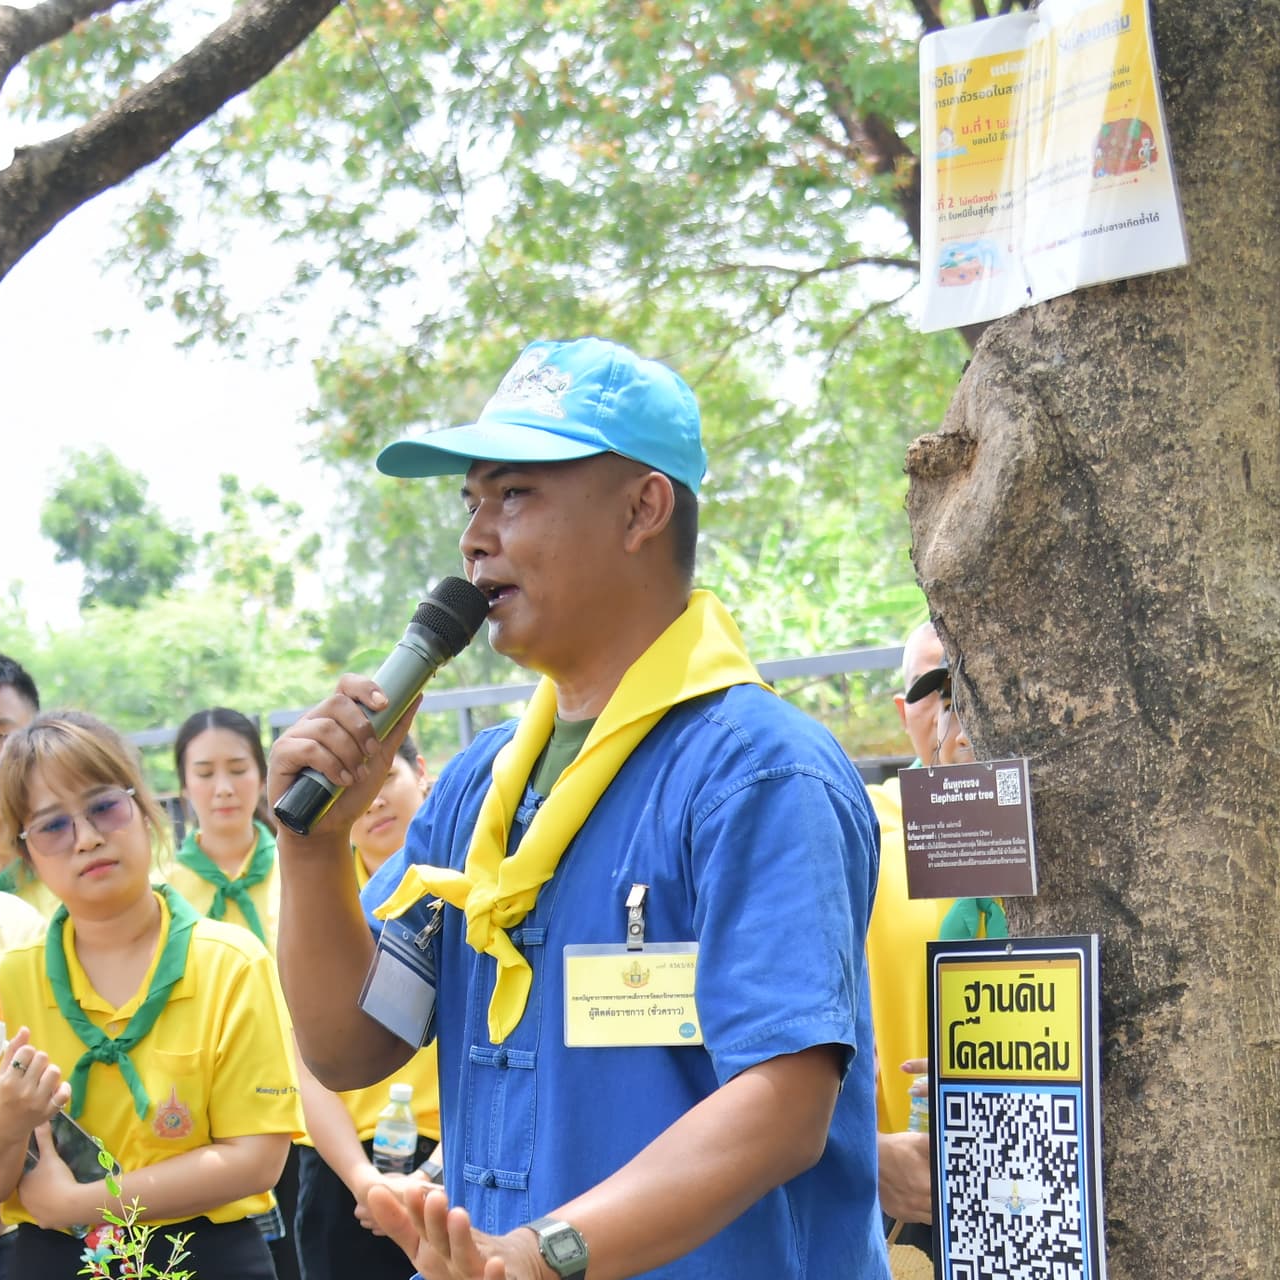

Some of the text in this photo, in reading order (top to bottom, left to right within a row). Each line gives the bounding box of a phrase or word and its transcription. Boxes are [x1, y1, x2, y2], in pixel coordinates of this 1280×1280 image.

[947, 197, 954, 208] 2
[931, 790, 995, 805] Elephant ear tree
[964, 973, 1055, 1024] ฐานดิน
[589, 1003, 685, 1020] ผู้ติดต่อราชการ (ชั่วคราว)
[949, 1020, 1070, 1072] โคลนถล่ม
